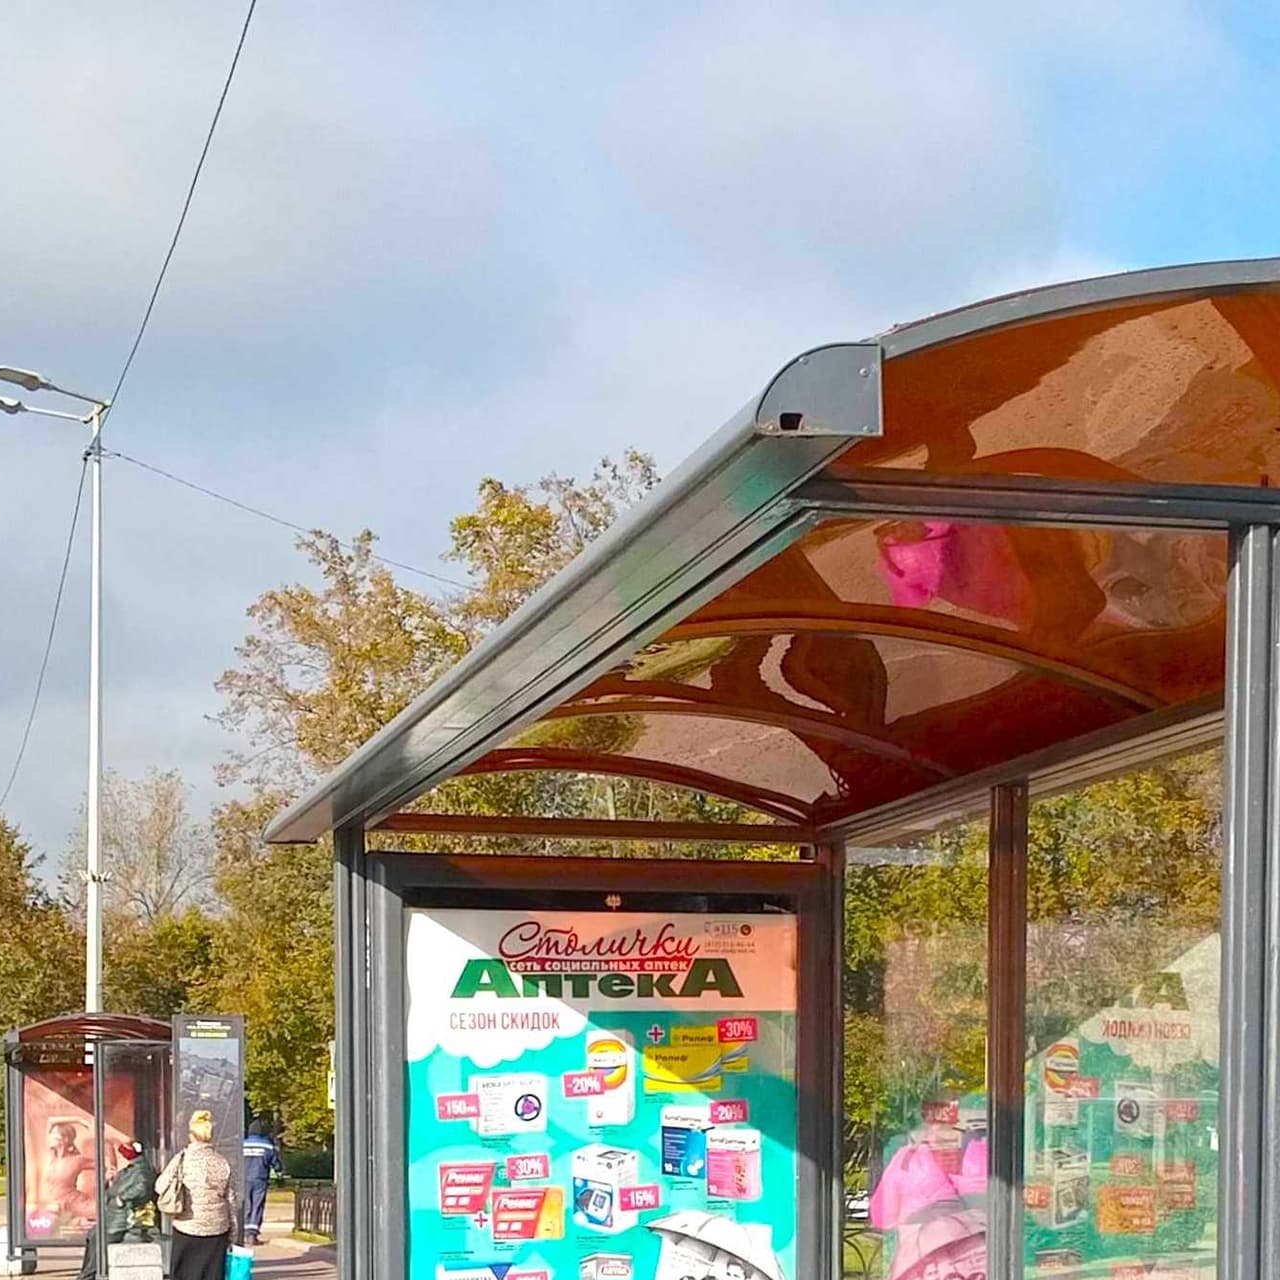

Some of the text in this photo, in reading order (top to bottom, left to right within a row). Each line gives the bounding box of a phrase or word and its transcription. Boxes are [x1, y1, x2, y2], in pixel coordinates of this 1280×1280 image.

[499, 921, 702, 958] Столички
[510, 959, 689, 973] сеть социальных аптек
[450, 957, 744, 999] АптекА
[450, 1011, 560, 1031] СЕЗОН СКИДОК
[720, 1021, 753, 1038] -30%
[566, 1075, 601, 1093] -20%
[713, 1104, 744, 1121] -20%
[510, 1158, 544, 1176] -30%
[622, 1191, 656, 1208] -15%
